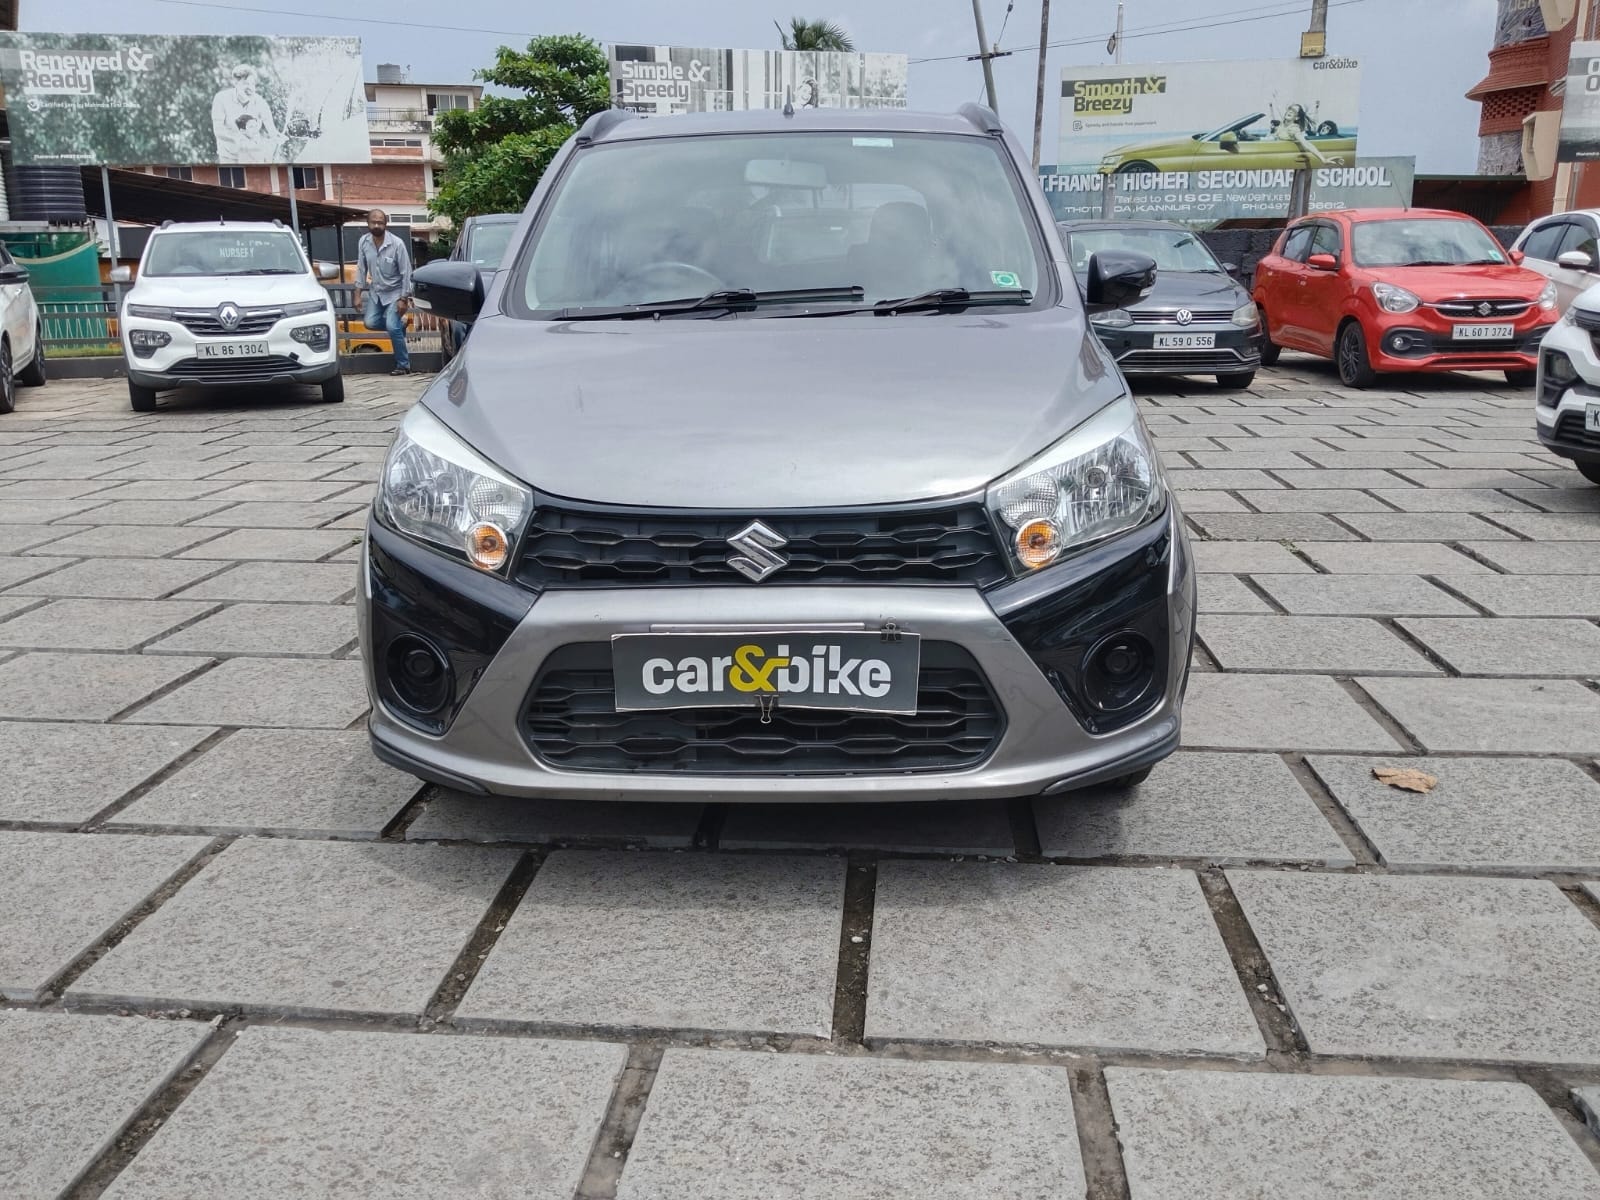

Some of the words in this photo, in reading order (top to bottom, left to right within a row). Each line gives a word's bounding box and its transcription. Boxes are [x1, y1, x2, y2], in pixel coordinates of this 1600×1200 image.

[19, 49, 123, 71] Renewed
[127, 46, 153, 71] &
[1313, 58, 1358, 70] car&bike
[22, 68, 91, 94] Ready
[621, 60, 683, 80] Simple
[688, 59, 711, 82] &
[623, 79, 689, 102] Speedy
[1074, 78, 1141, 97] Smooth
[1143, 73, 1167, 94] &
[1074, 96, 1133, 114] Breezy
[1122, 171, 1188, 191] HIGHER
[1198, 169, 1293, 189] SECONDAR
[1316, 166, 1393, 187] SCHOOL
[1150, 194, 1162, 204] to
[1159, 337, 1171, 347] KL
[1172, 336, 1184, 346] 59
[1195, 336, 1212, 346] 556
[1459, 327, 1470, 337] KL
[1472, 327, 1483, 337] 60
[1485, 327, 1490, 337] T
[1492, 327, 1513, 337] 3724
[205, 345, 218, 356] KL
[221, 344, 234, 355] 86
[238, 343, 265, 355] 1304
[642, 644, 891, 698] car&bike
